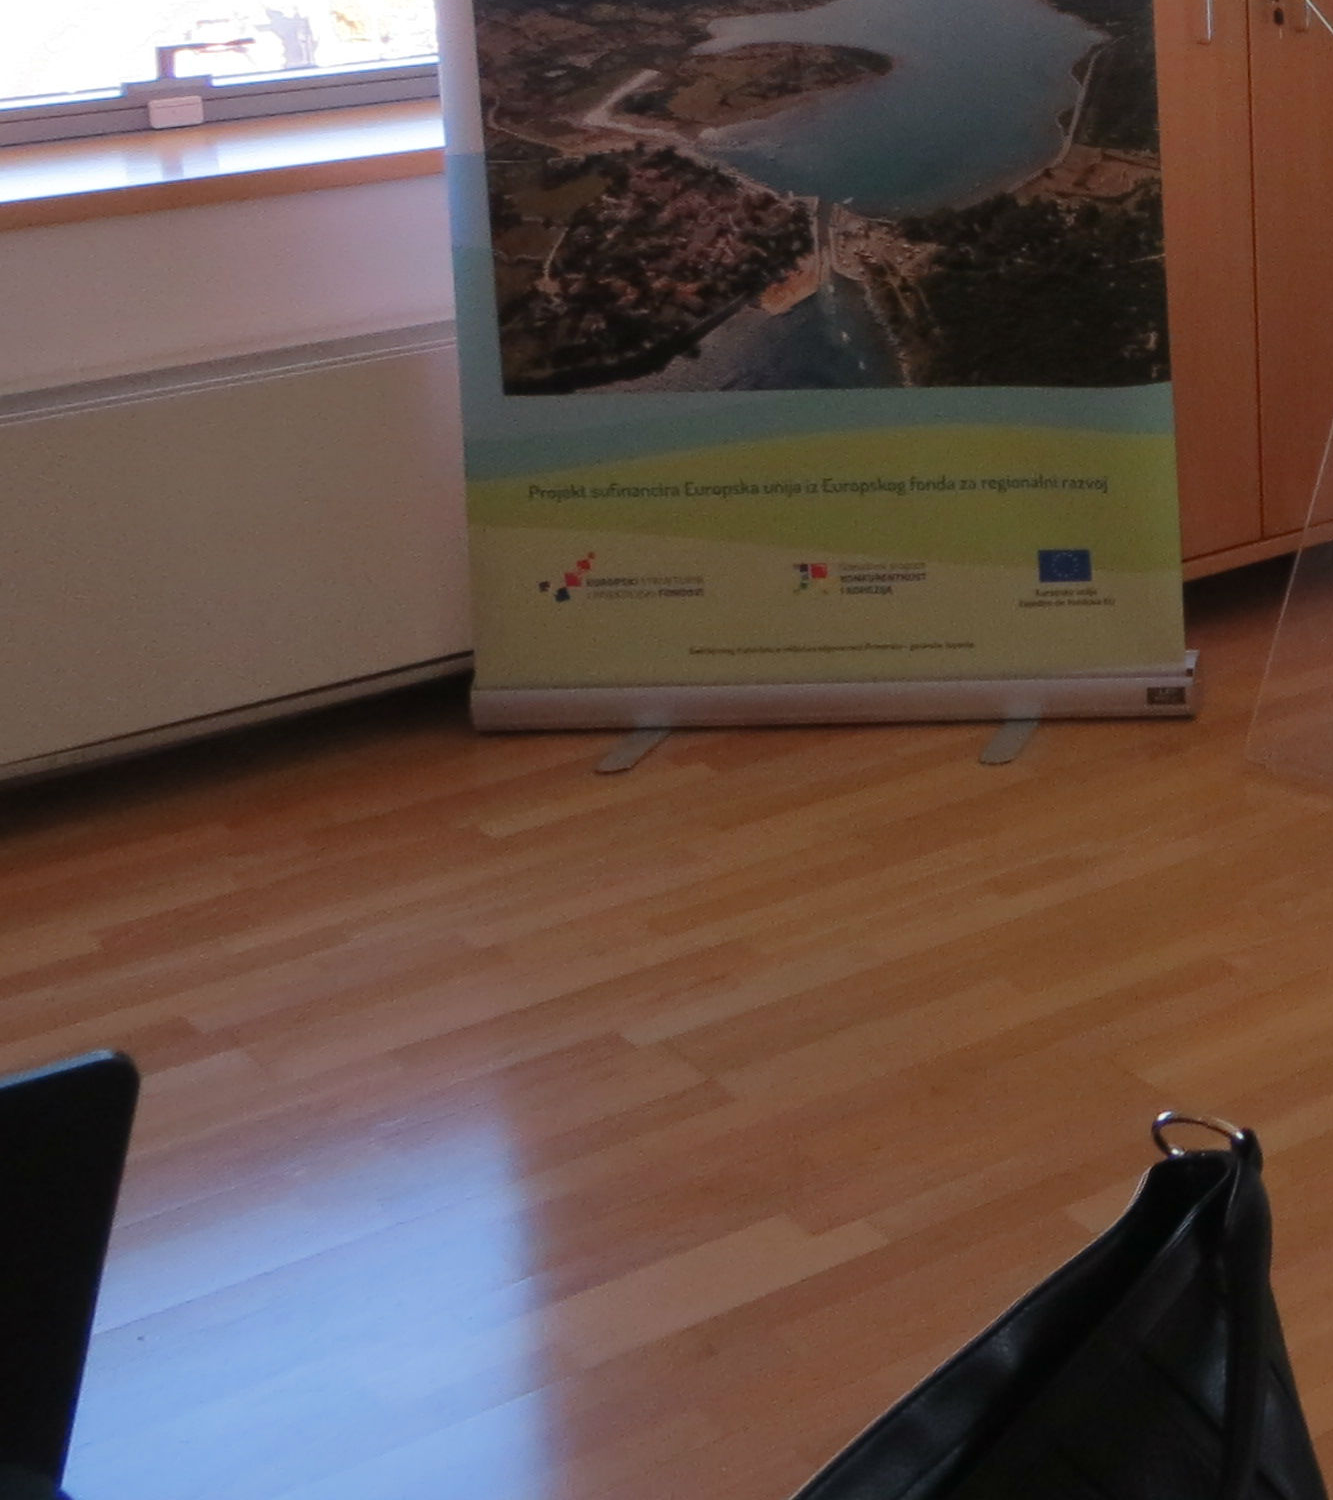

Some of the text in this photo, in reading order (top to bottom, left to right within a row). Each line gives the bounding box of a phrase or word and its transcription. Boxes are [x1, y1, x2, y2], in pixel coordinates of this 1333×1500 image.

[528, 474, 1109, 502] Projekt sufinancira Europska unija iz Europskog fonda za regionalni razvoj
